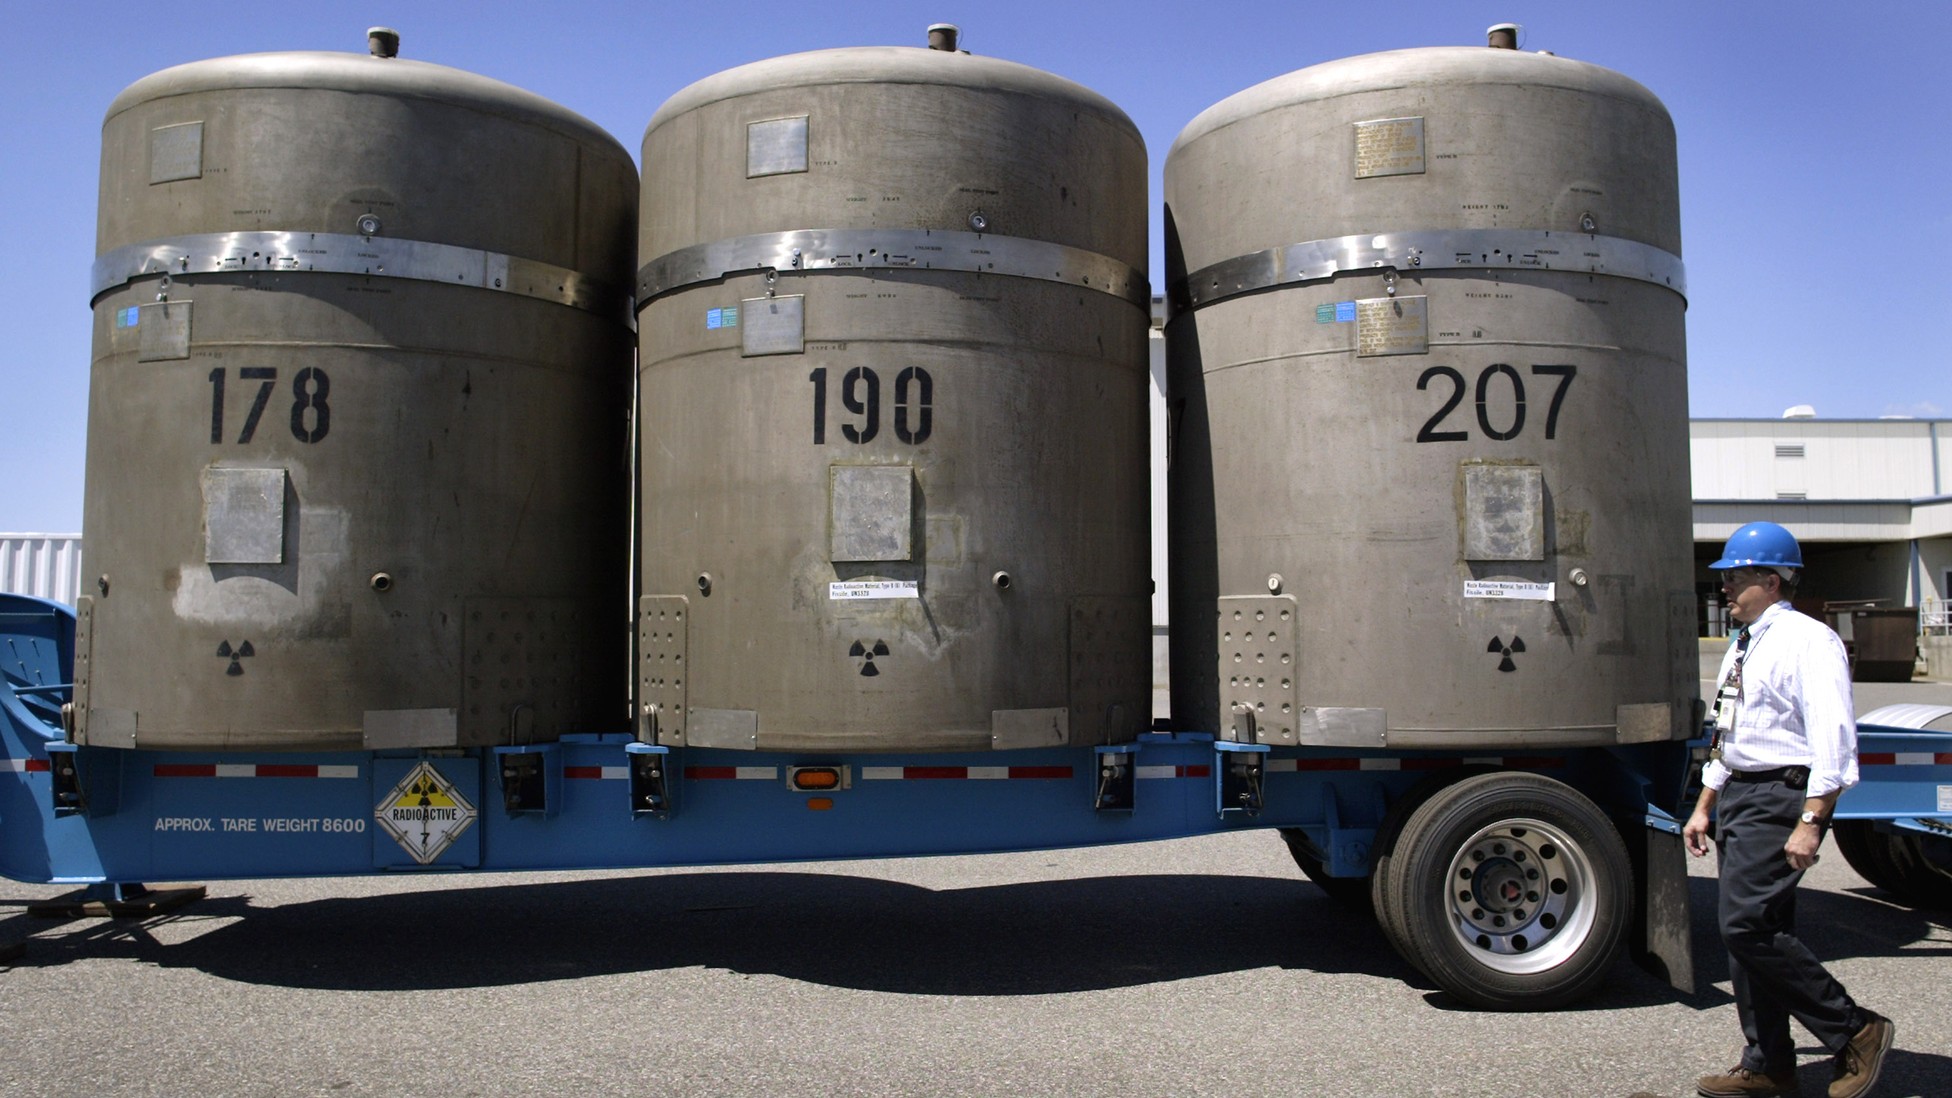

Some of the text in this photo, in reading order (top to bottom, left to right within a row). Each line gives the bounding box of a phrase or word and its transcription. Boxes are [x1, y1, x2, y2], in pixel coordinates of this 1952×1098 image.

[209, 367, 331, 445] 178
[810, 366, 933, 446] 190
[1416, 364, 1578, 443] 207
[155, 818, 365, 832] APPROX. TARE WEIGHT 8600
[393, 808, 457, 821] RADIOACTIVE
[420, 832, 431, 845] 7
